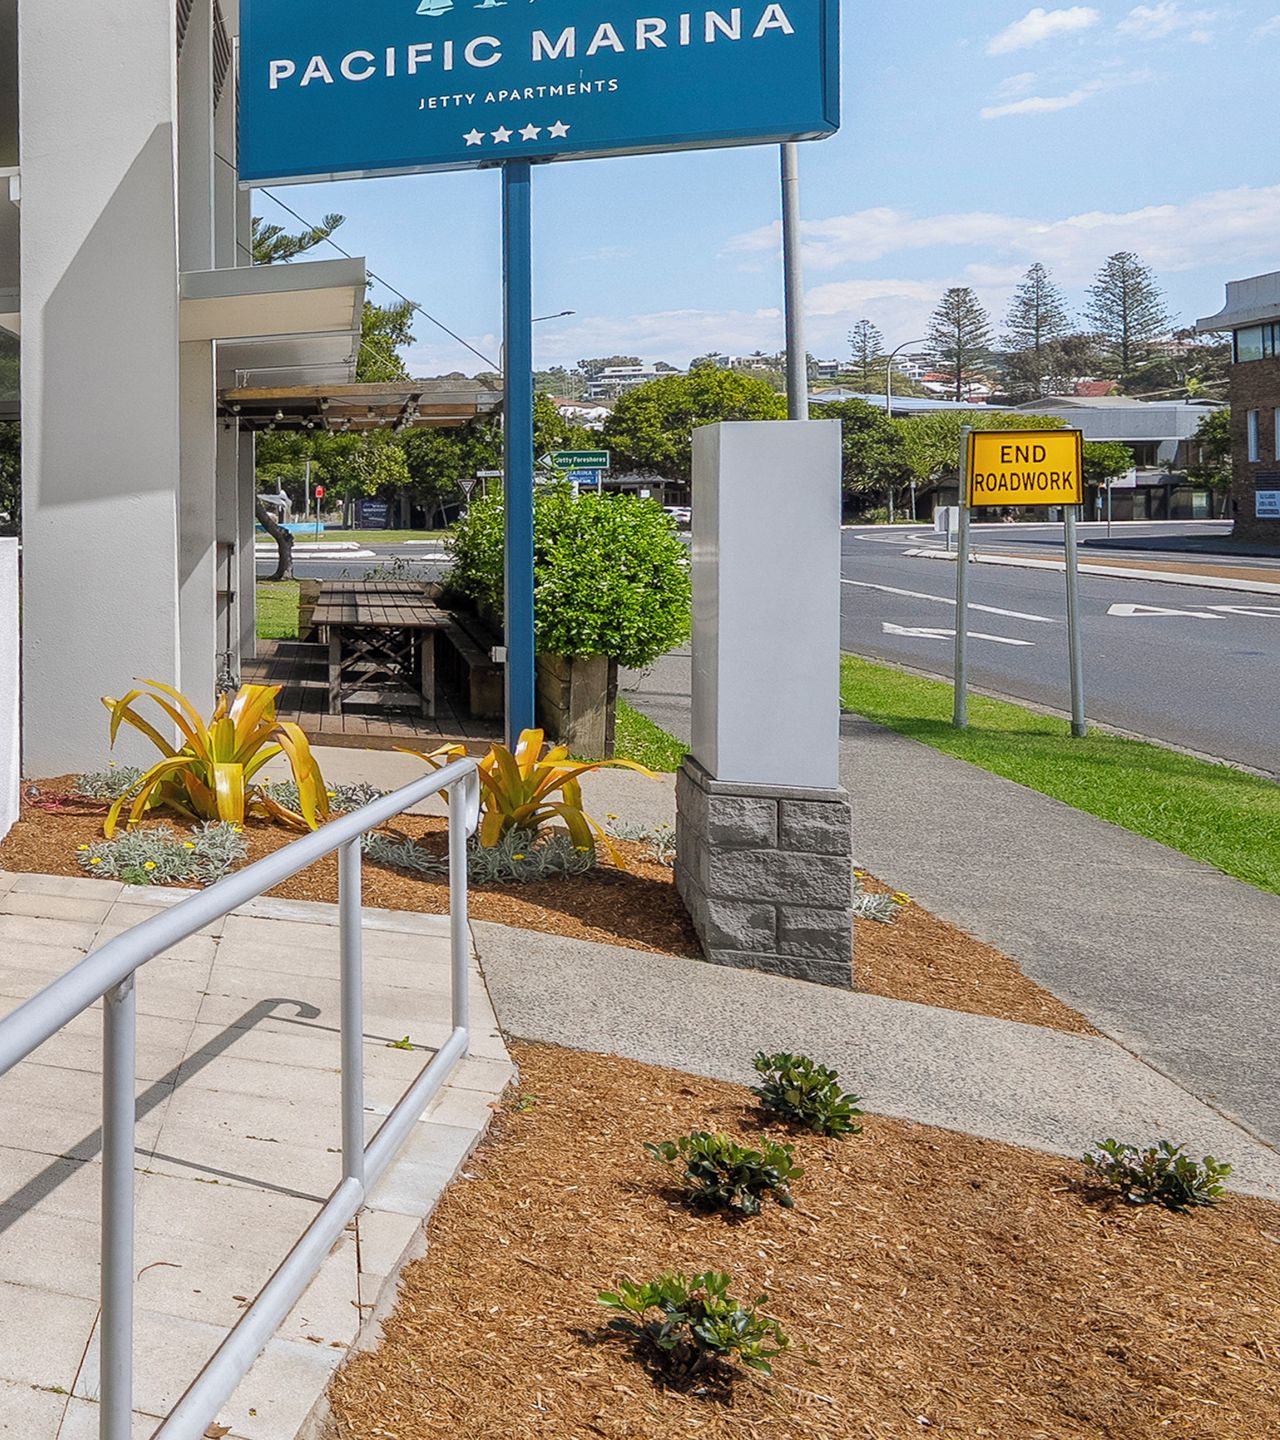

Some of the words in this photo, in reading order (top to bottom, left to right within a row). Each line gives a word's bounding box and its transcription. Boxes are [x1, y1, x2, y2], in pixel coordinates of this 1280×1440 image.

[268, 35, 503, 90] PACIFIC
[531, 2, 795, 62] MARINA
[418, 93, 476, 110] JETTY
[484, 78, 619, 104] APARTMENTS
[1000, 445, 1047, 464] END
[974, 471, 1074, 492] ROADWORK
